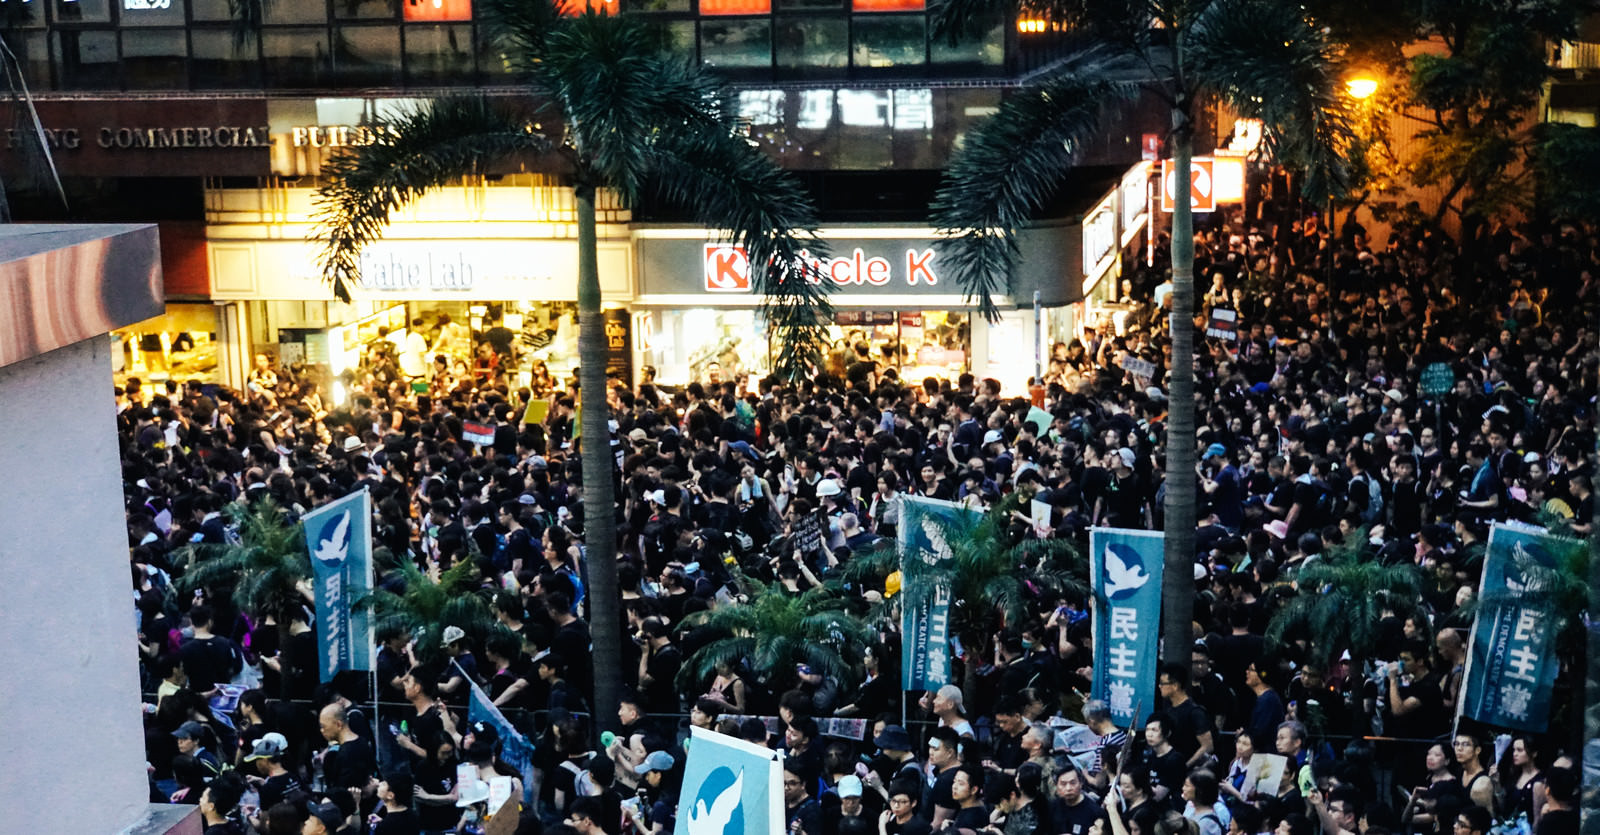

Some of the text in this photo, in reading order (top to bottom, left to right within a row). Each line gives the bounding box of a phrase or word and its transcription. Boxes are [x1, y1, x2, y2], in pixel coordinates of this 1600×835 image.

[98, 126, 276, 148] COMMERCIAL
[292, 126, 402, 147] BUILDIN
[428, 252, 473, 291] Lab
[768, 248, 937, 286] ircle K
[914, 598, 928, 681] MOCRATIC PARTY
[1108, 606, 1138, 718] 民主黨
